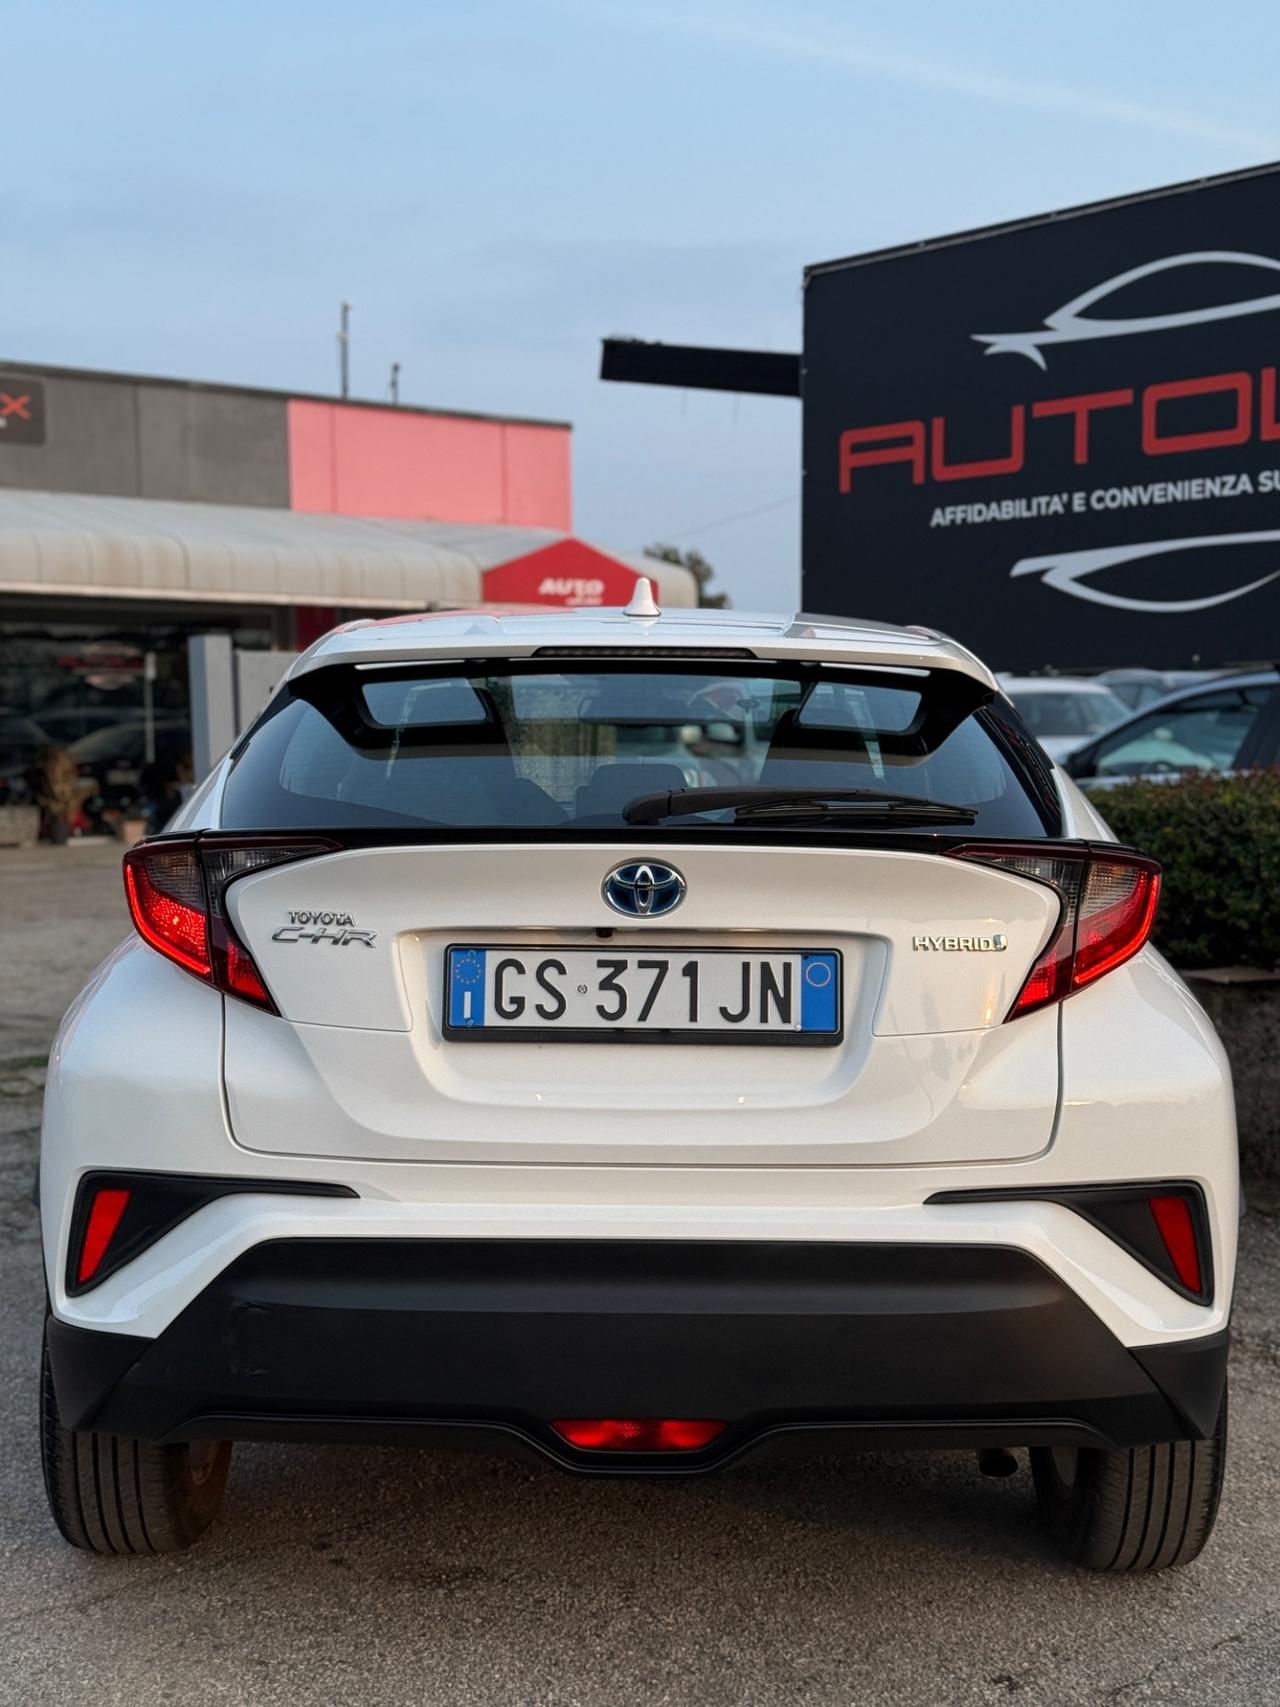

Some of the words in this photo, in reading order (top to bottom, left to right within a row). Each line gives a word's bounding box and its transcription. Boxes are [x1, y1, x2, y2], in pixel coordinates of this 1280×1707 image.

[930, 494, 1069, 527] AFFIDABILITA'
[1072, 492, 1087, 512] E
[1090, 474, 1253, 511] CONVENIENZA
[538, 577, 605, 596] AUTO
[288, 911, 355, 927] TOYOTA
[272, 926, 377, 948] C-HR
[912, 936, 996, 952] HYBRID
[494, 958, 567, 1021] GS
[596, 960, 698, 1022] 371
[719, 961, 792, 1023] JN
